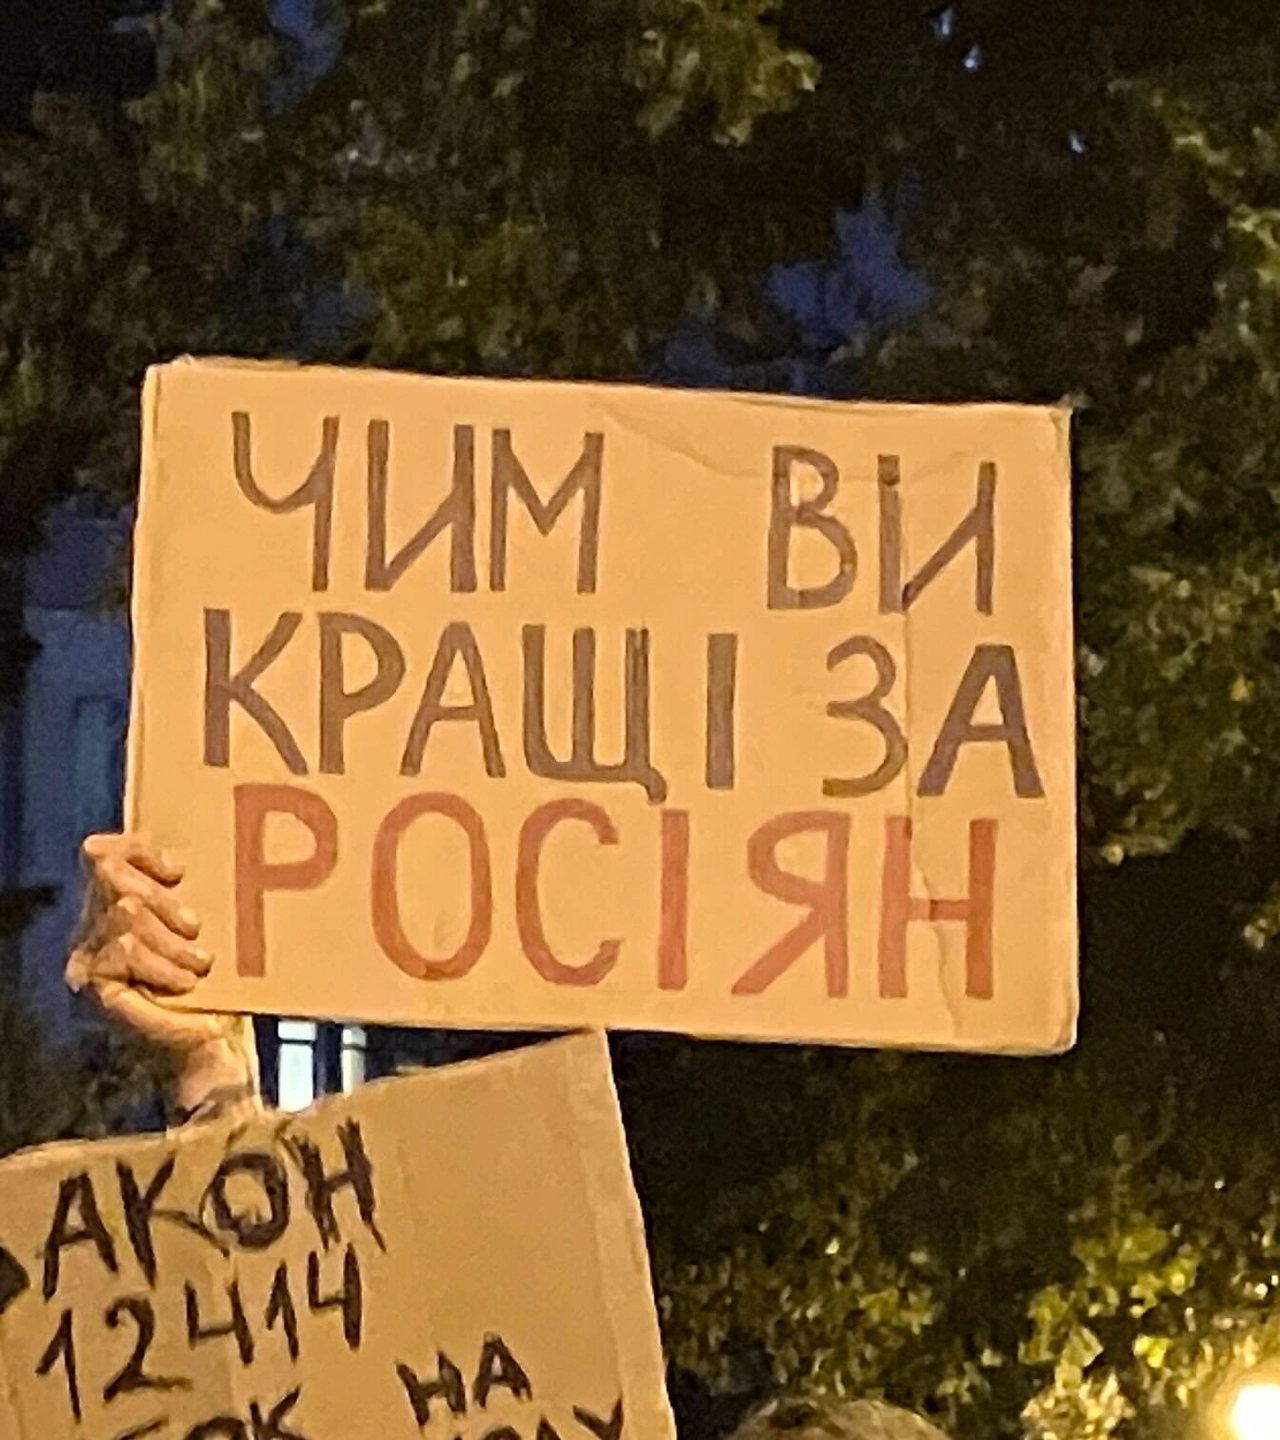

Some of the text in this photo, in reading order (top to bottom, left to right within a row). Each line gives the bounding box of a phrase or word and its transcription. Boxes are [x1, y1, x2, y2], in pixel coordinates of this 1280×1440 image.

[231, 411, 998, 618] ЧИМ ВИ
[202, 606, 1046, 806] КРАЩІ ЗА
[232, 783, 998, 1000] РОСІЯН
[35, 1242, 364, 1426] 12414
[395, 1333, 533, 1435] НА
